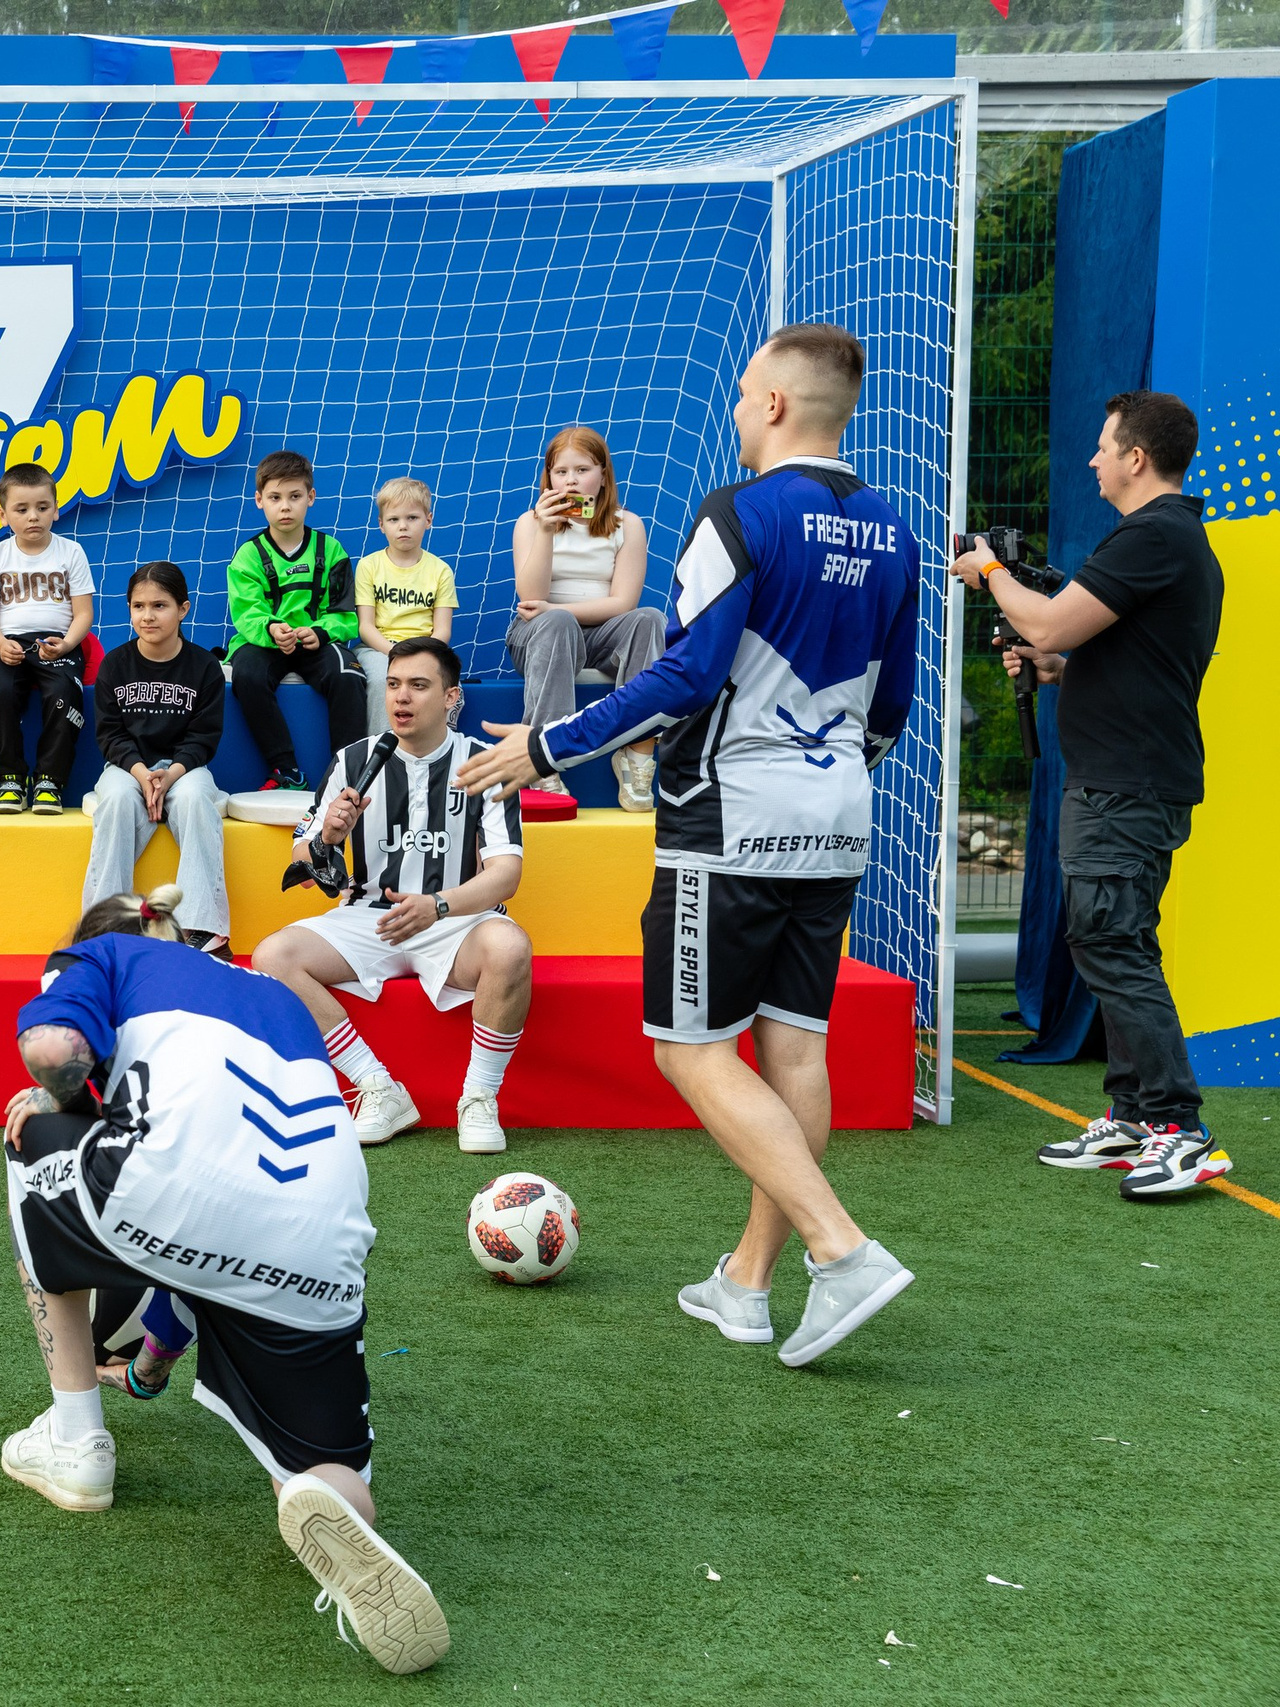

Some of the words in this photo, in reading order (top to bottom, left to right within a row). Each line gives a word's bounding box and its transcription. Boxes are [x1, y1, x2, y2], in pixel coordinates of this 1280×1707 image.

[803, 513, 897, 553] FREESTYLE
[114, 682, 197, 711] PERFECT
[378, 824, 451, 859] Jeep
[680, 945, 699, 1007] SPORT
